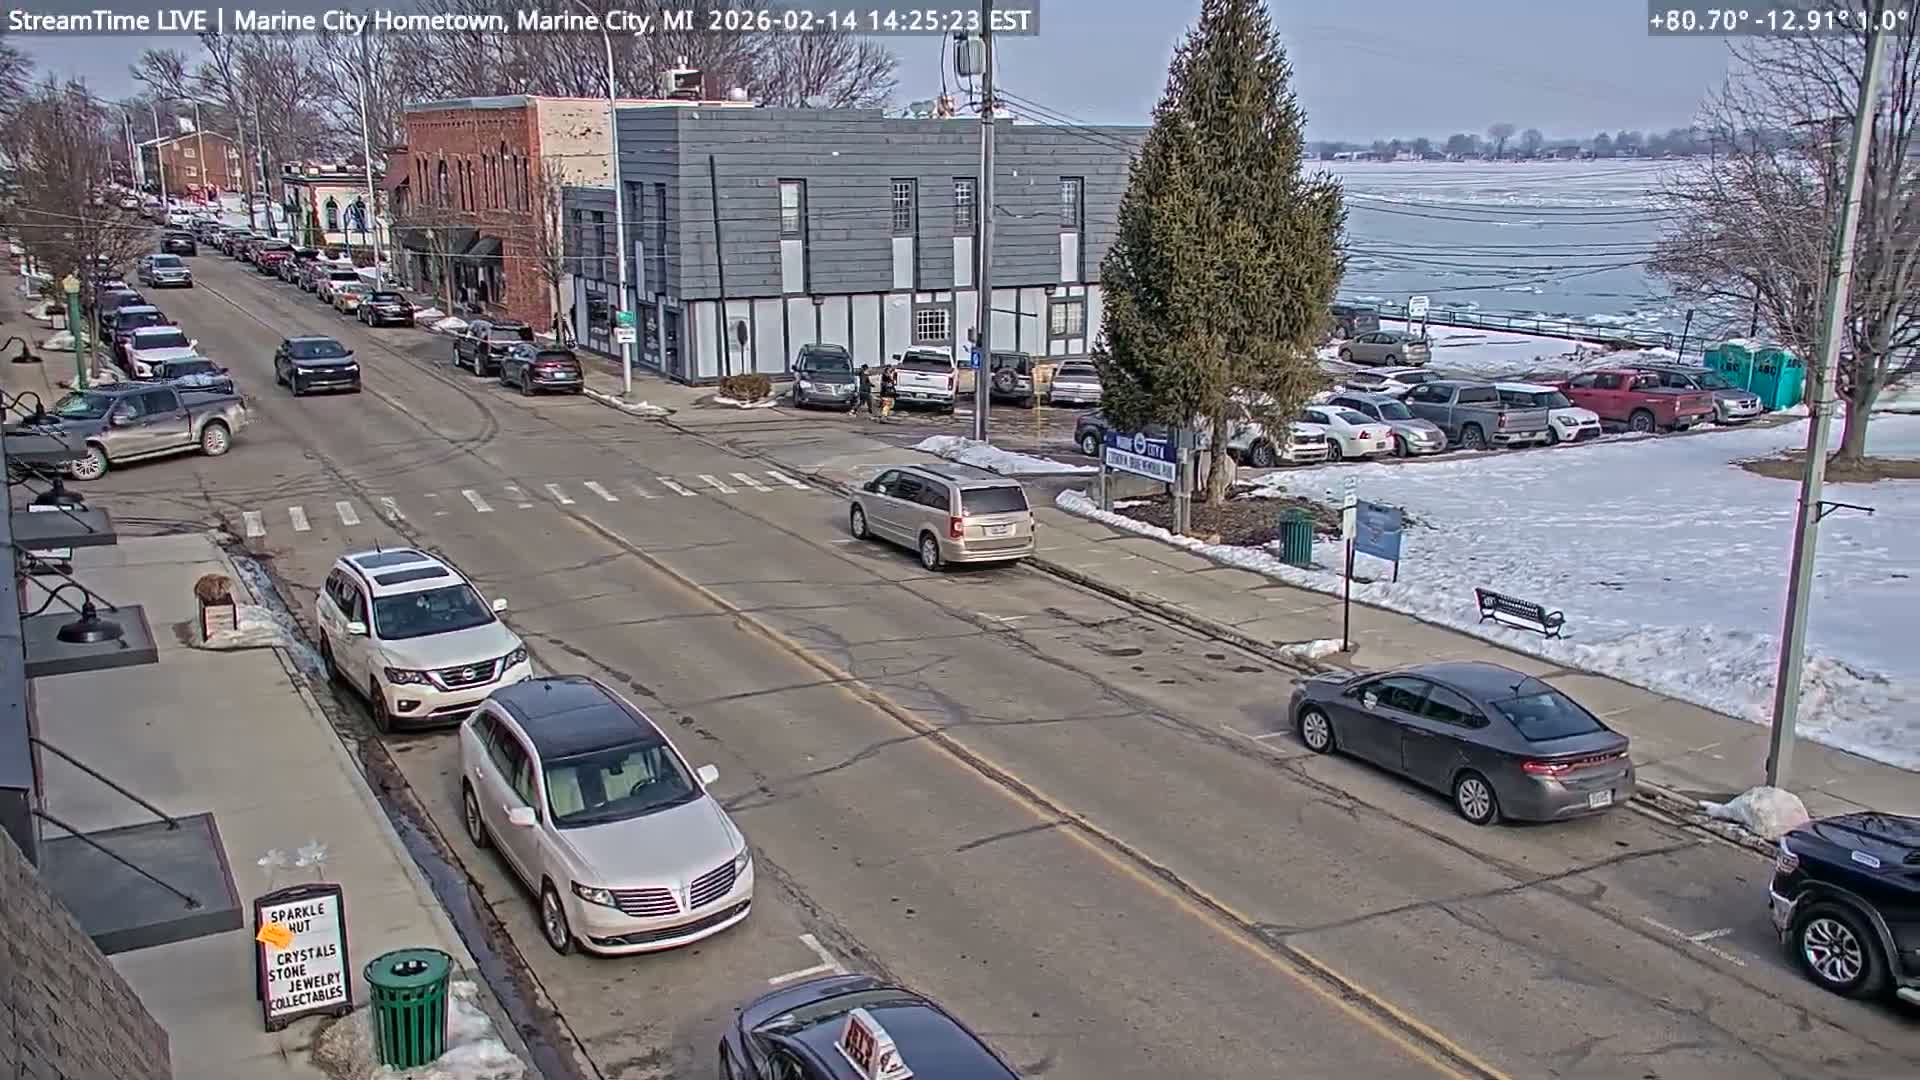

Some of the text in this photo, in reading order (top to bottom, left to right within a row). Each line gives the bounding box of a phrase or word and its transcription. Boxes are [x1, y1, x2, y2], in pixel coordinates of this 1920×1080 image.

[271, 903, 325, 923] SPARKLE
[289, 920, 311, 933] HUT
[277, 944, 336, 965] CRYSTALS
[269, 964, 306, 982] STONE
[289, 971, 341, 993] JEWELRY
[270, 986, 343, 1011] COLLECTABLES
